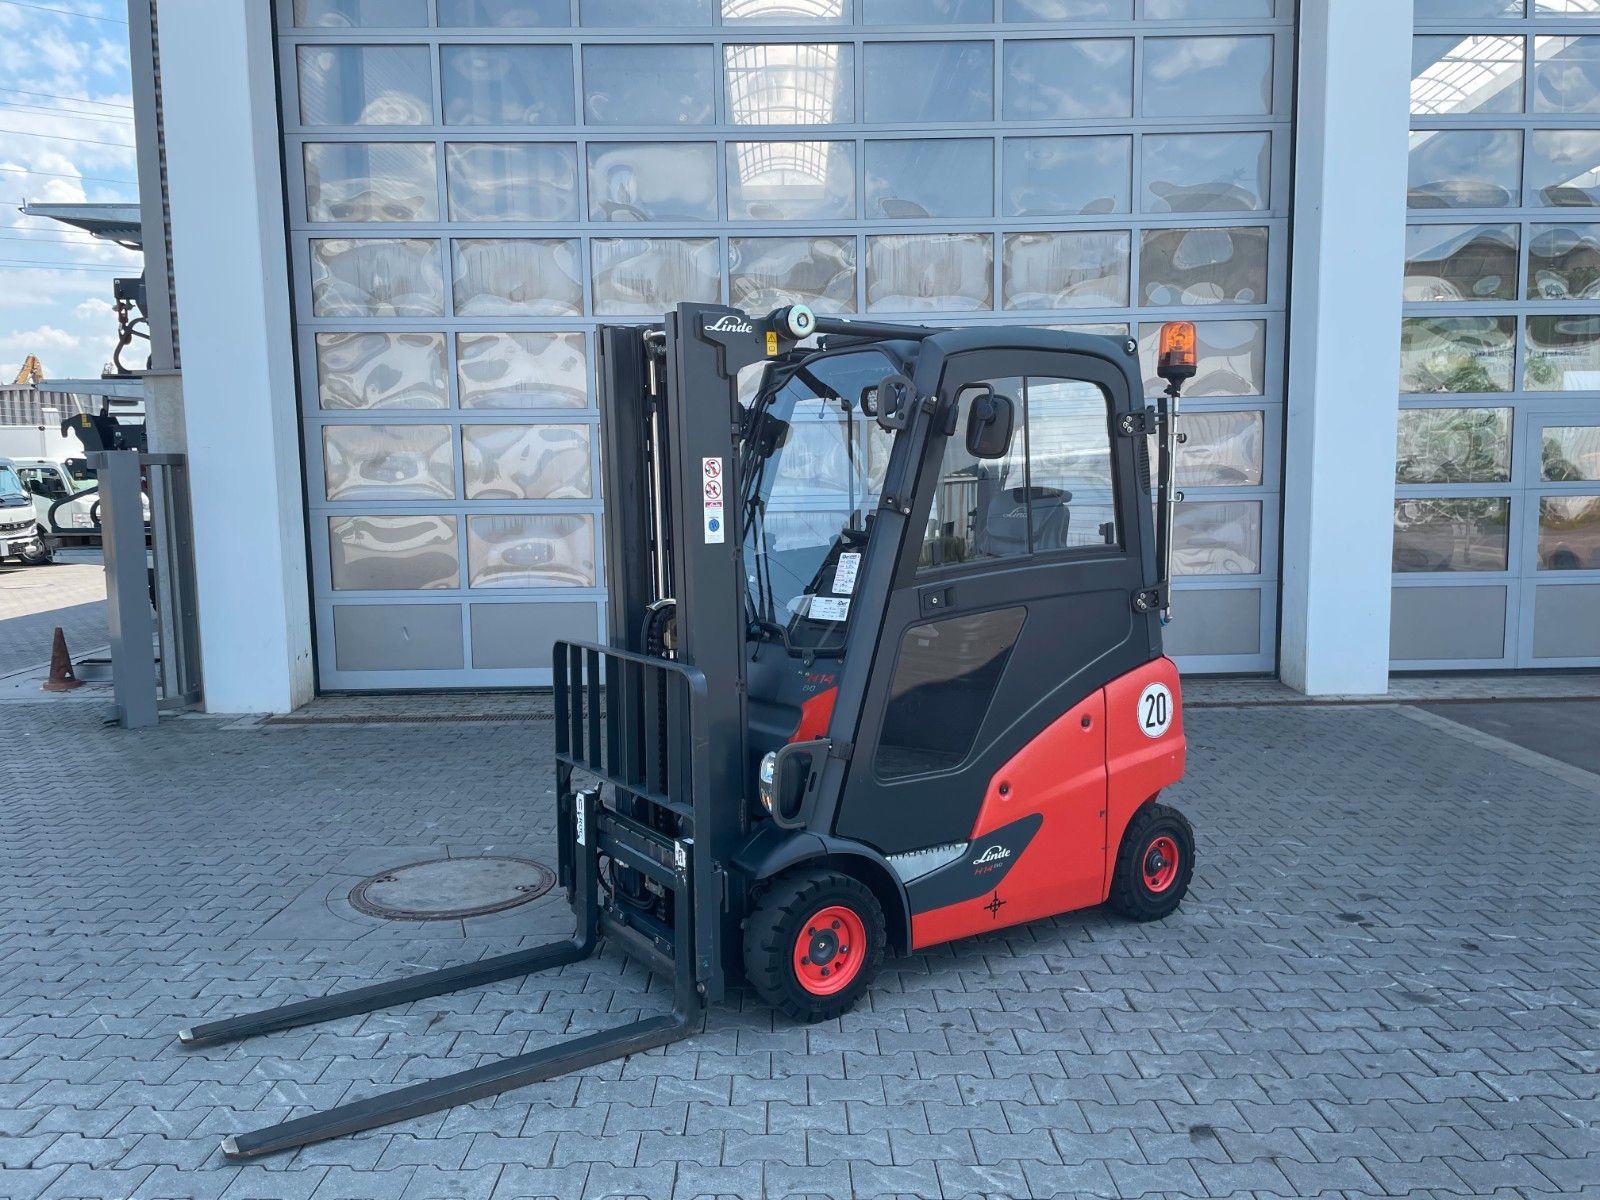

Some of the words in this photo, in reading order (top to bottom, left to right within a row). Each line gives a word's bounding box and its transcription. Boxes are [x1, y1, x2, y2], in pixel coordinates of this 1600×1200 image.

[704, 315, 753, 334] Linde
[1145, 692, 1167, 728] 20
[973, 846, 1010, 864] Linde
